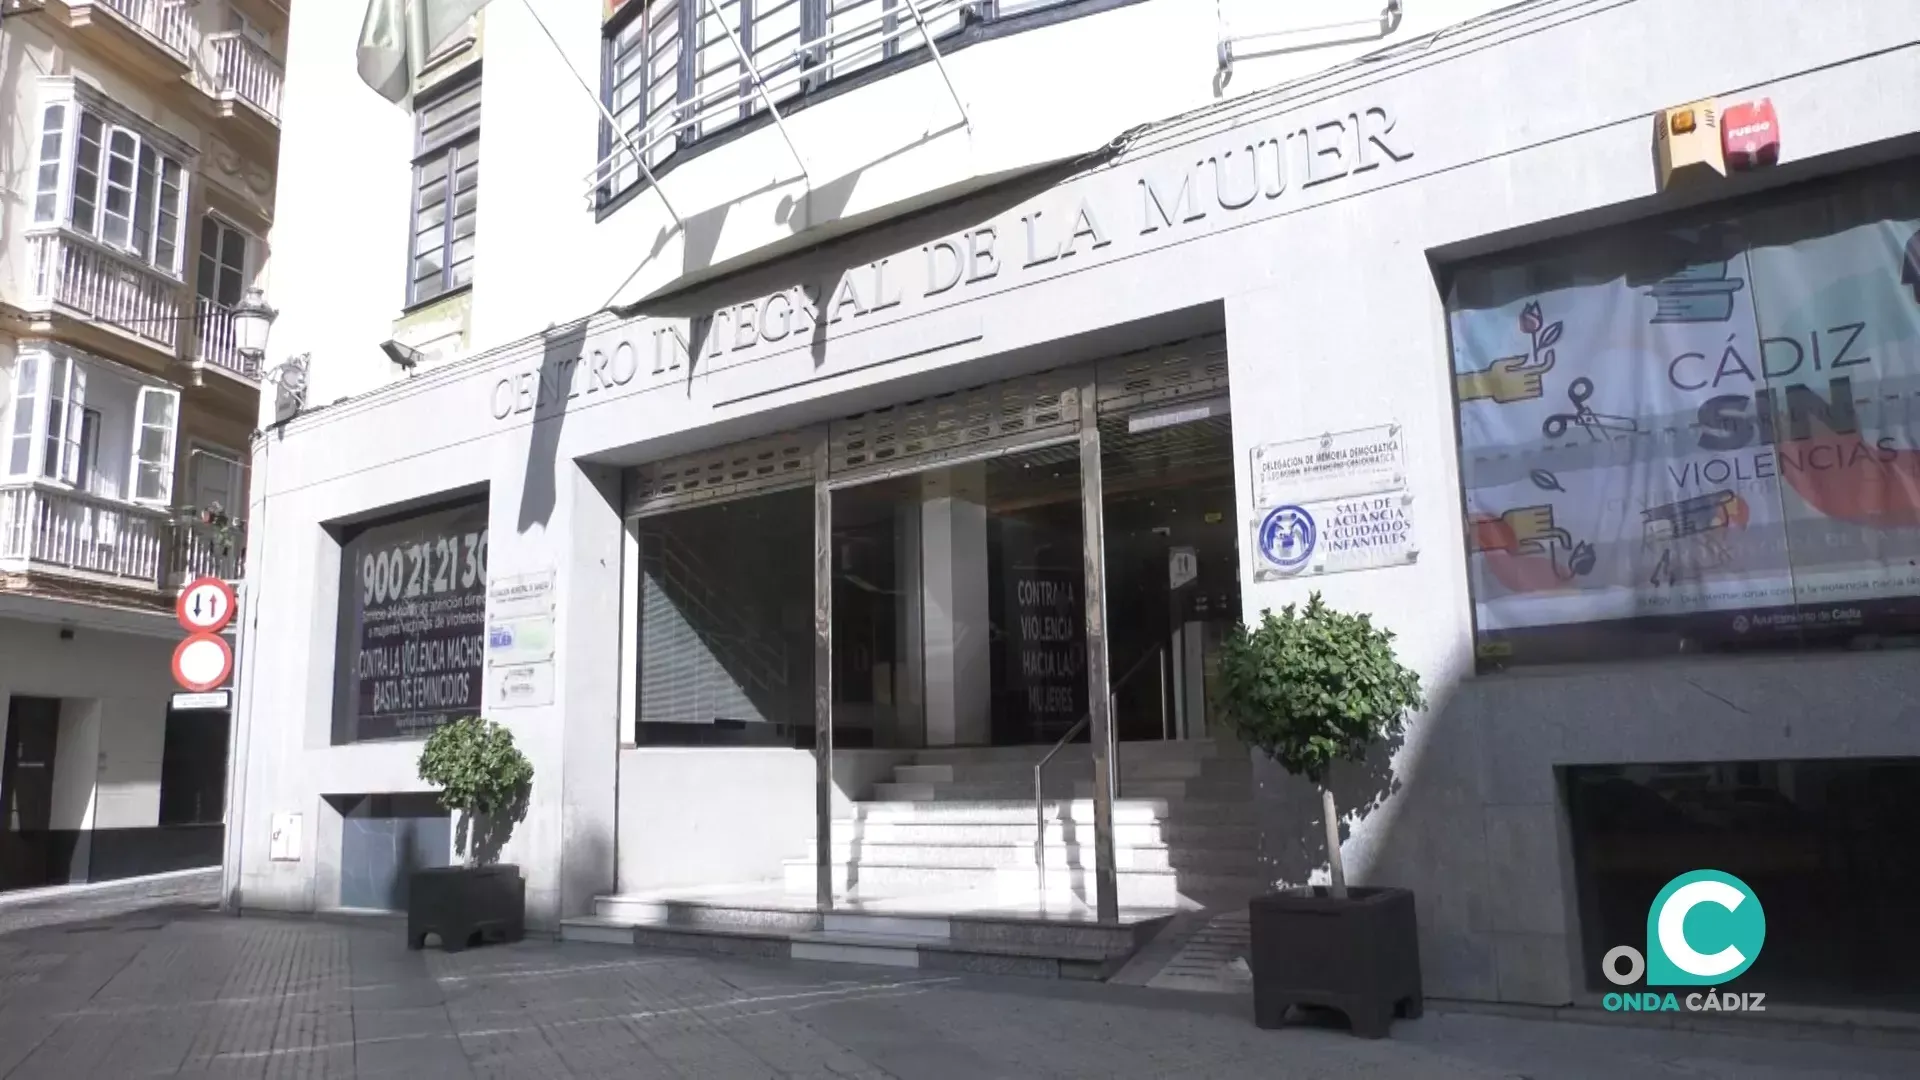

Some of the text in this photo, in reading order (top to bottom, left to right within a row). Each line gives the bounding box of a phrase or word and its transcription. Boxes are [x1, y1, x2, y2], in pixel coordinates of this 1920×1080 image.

[1728, 121, 1771, 139] FUEGO
[489, 106, 1415, 421] CENTRO INTEGRAL DE LA MUJER
[1668, 321, 1872, 391] CÁDIZ
[1697, 375, 1858, 452] SIN
[1315, 449, 1348, 464] MEMORIA
[1668, 437, 1899, 489] VIOLENCIAS
[1326, 508, 1405, 528] LACTANCIA
[1336, 497, 1391, 514] SALA DE
[1322, 519, 1411, 541] Y CUIDADOS
[1328, 532, 1407, 552] INFANTILES
[363, 547, 404, 606] 900
[405, 541, 431, 598] 21
[433, 535, 459, 593] 21
[1020, 615, 1073, 641] VIOLENCIA
[360, 646, 388, 679] CONTRA
[389, 645, 400, 676] LA
[402, 640, 445, 676] VIOLENCIA
[1022, 651, 1056, 676] HACIA
[374, 672, 470, 714] BASTA DE FEMINICIDIOS
[1028, 685, 1073, 713] MUJERES
